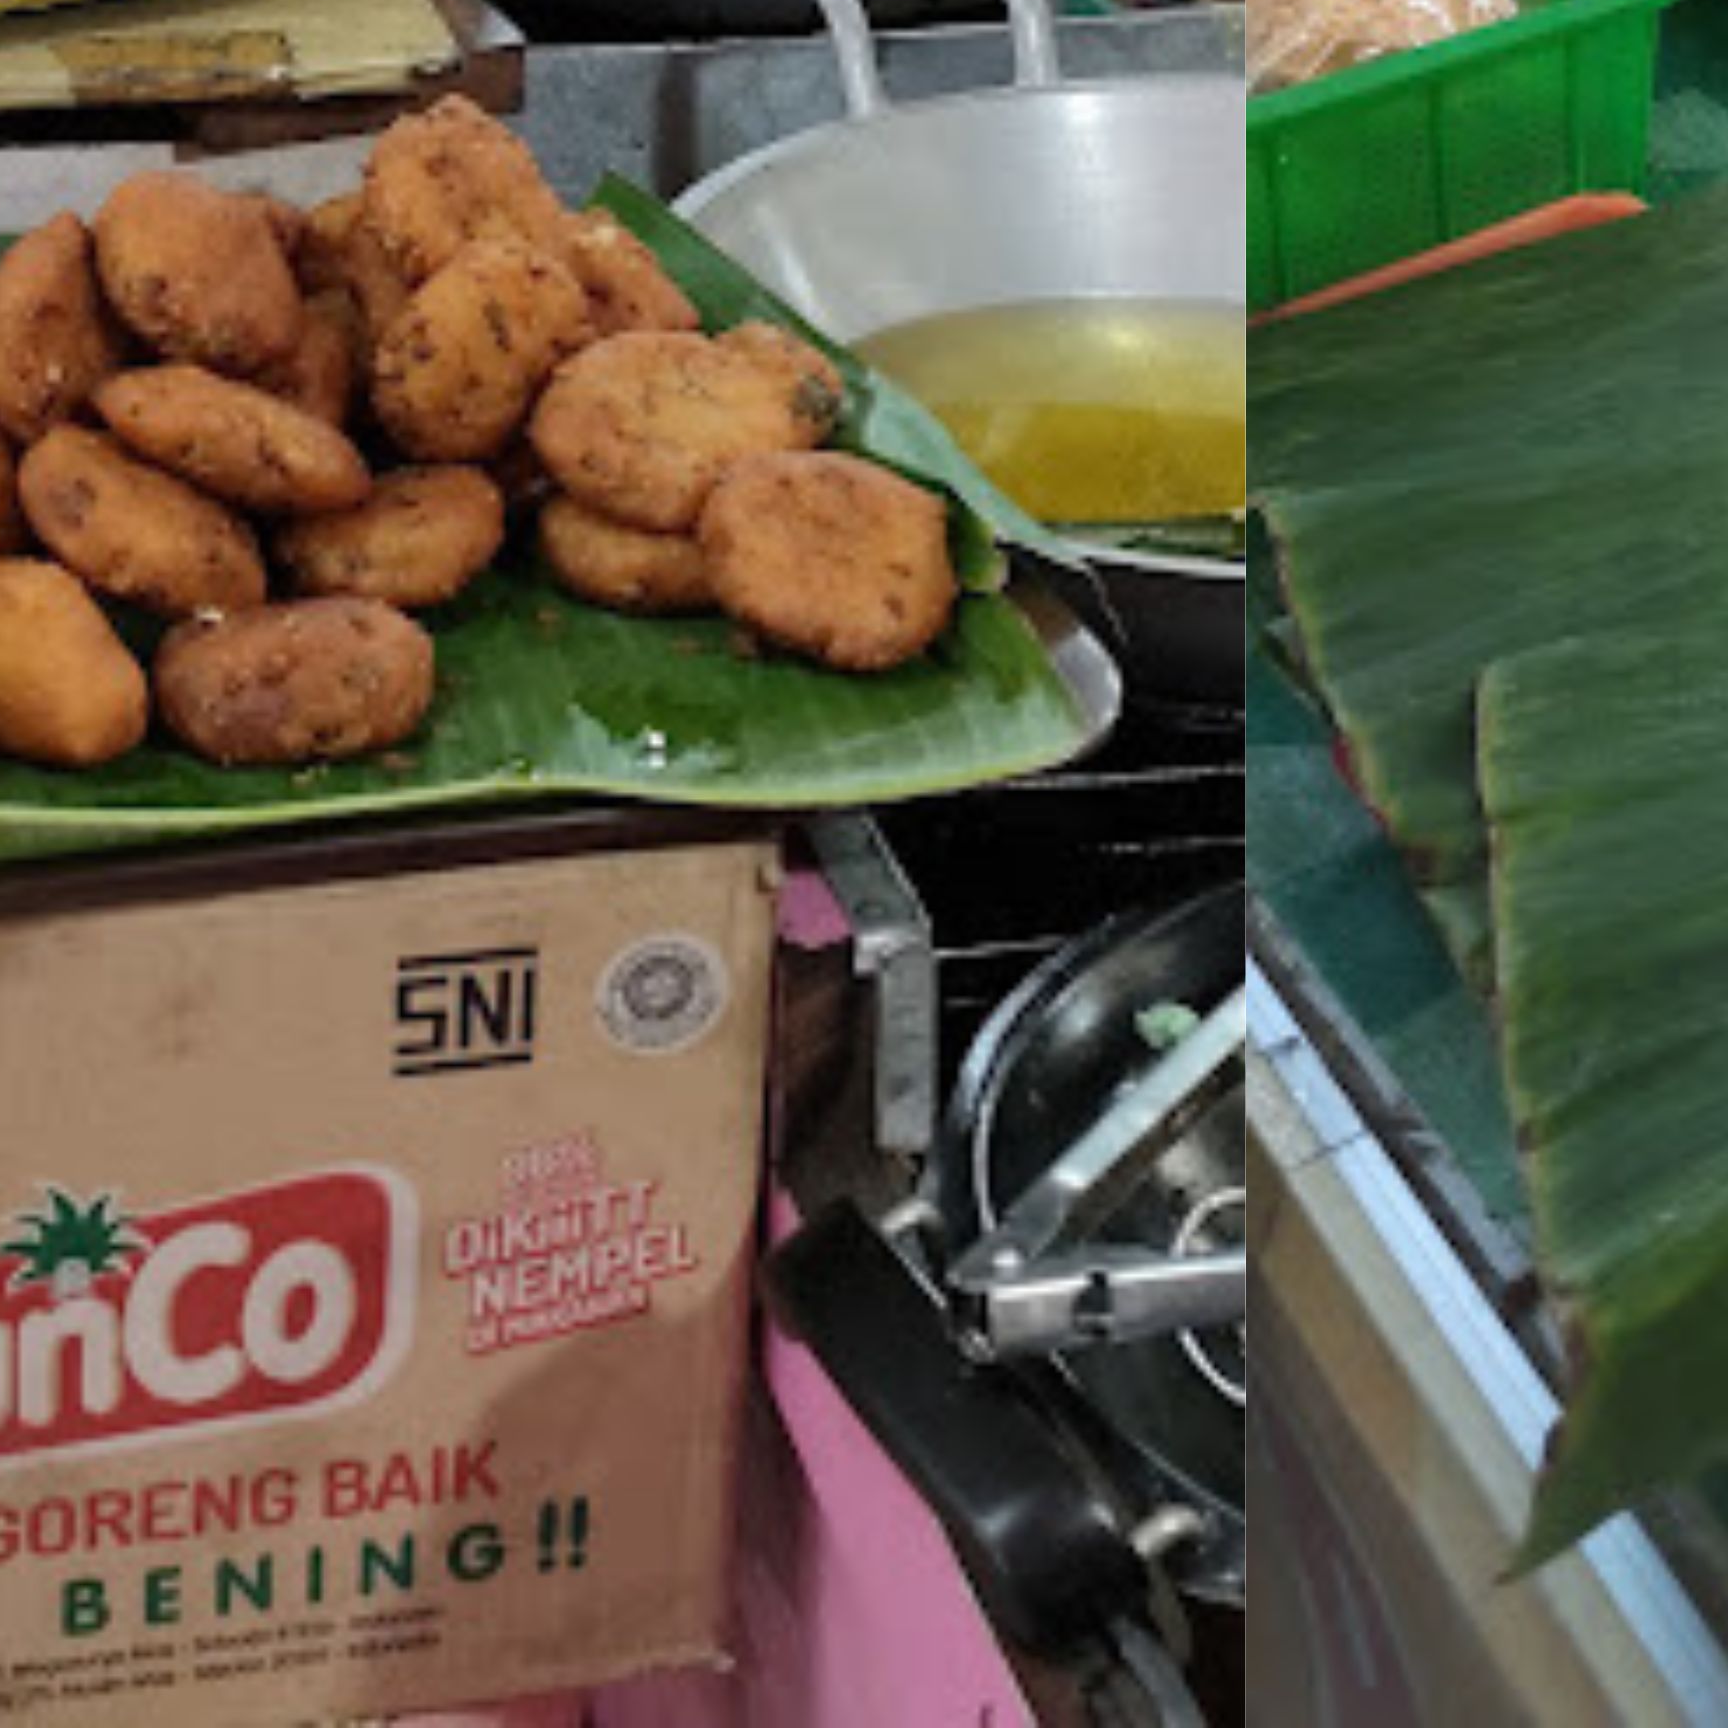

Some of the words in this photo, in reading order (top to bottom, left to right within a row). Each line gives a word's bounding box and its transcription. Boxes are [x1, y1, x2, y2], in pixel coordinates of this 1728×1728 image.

[396, 968, 534, 1056] SNI
[472, 1224, 700, 1320] NEMPEL
[323, 1440, 500, 1520] BAIK
[60, 1496, 590, 1638] BENING!!
